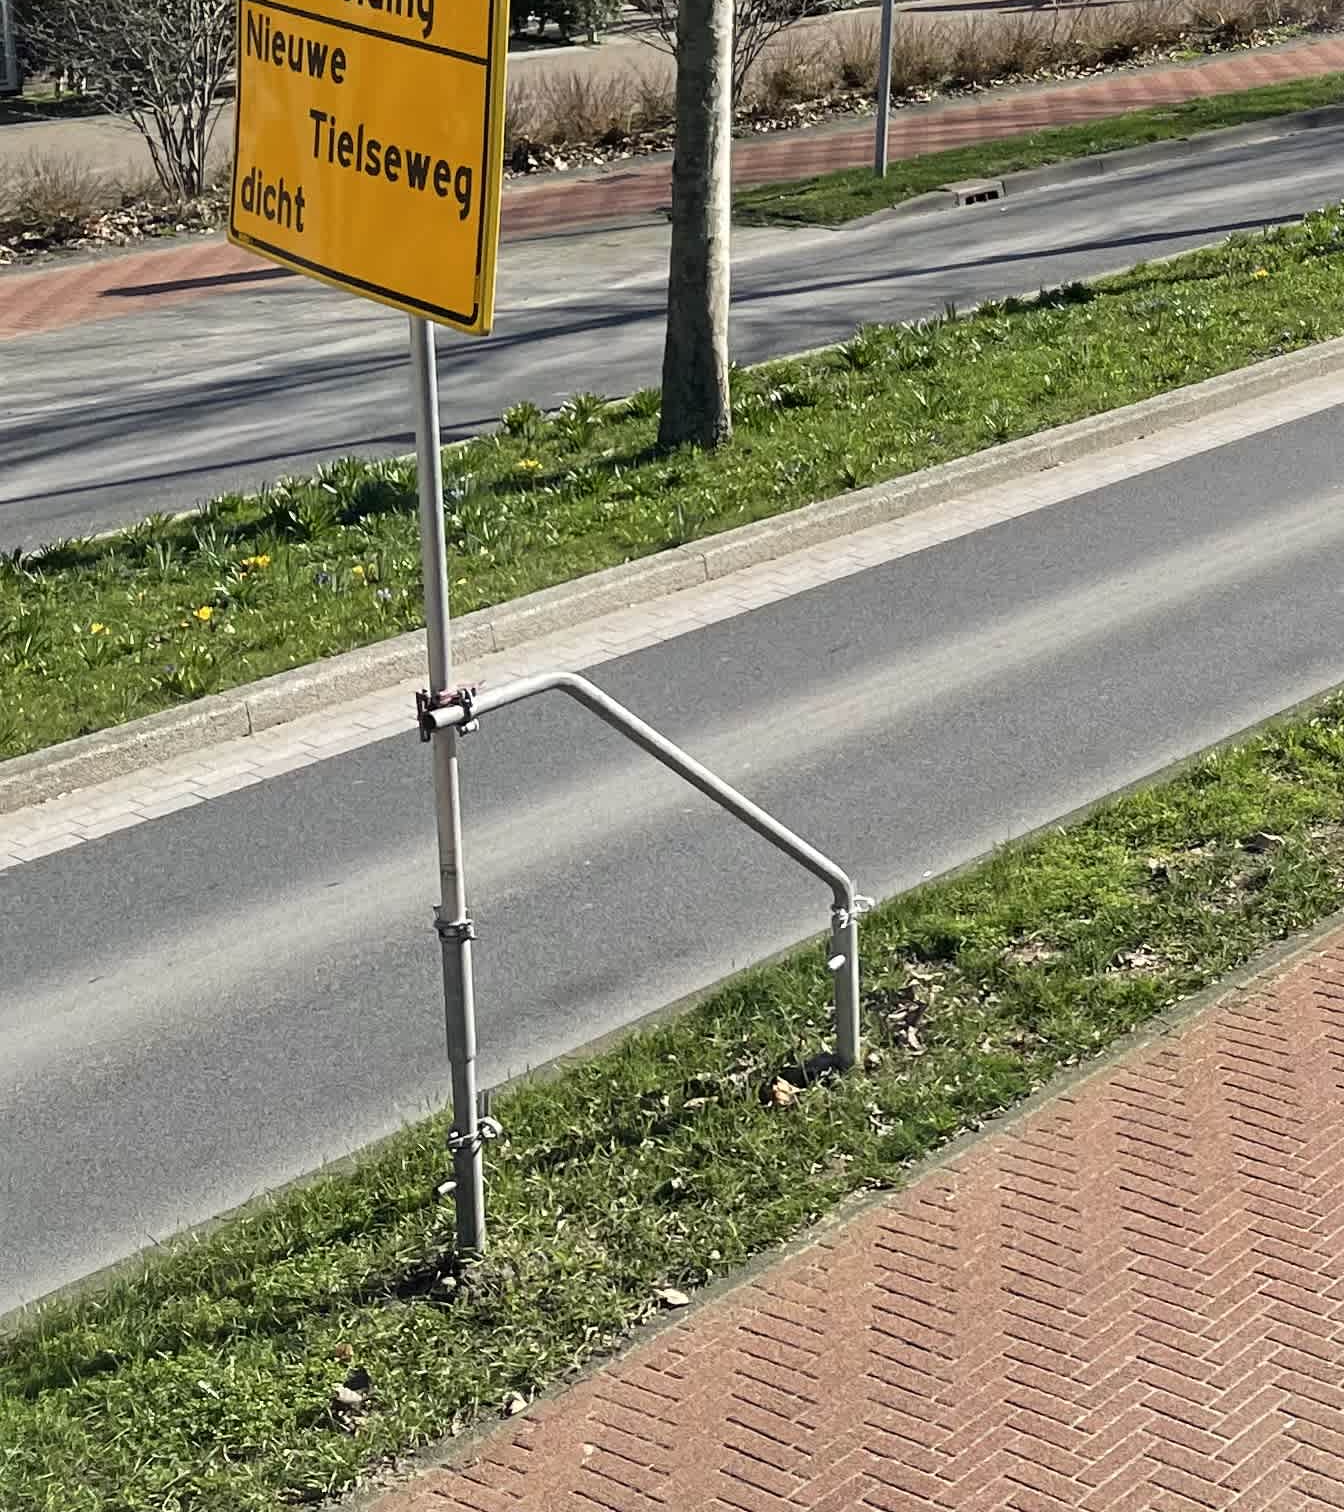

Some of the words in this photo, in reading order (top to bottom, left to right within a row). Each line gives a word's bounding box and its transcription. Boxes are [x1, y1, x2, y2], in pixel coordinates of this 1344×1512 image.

[247, 10, 346, 84] Nieuwe
[241, 167, 305, 232] dicht
[309, 109, 472, 220] Tielseweg
